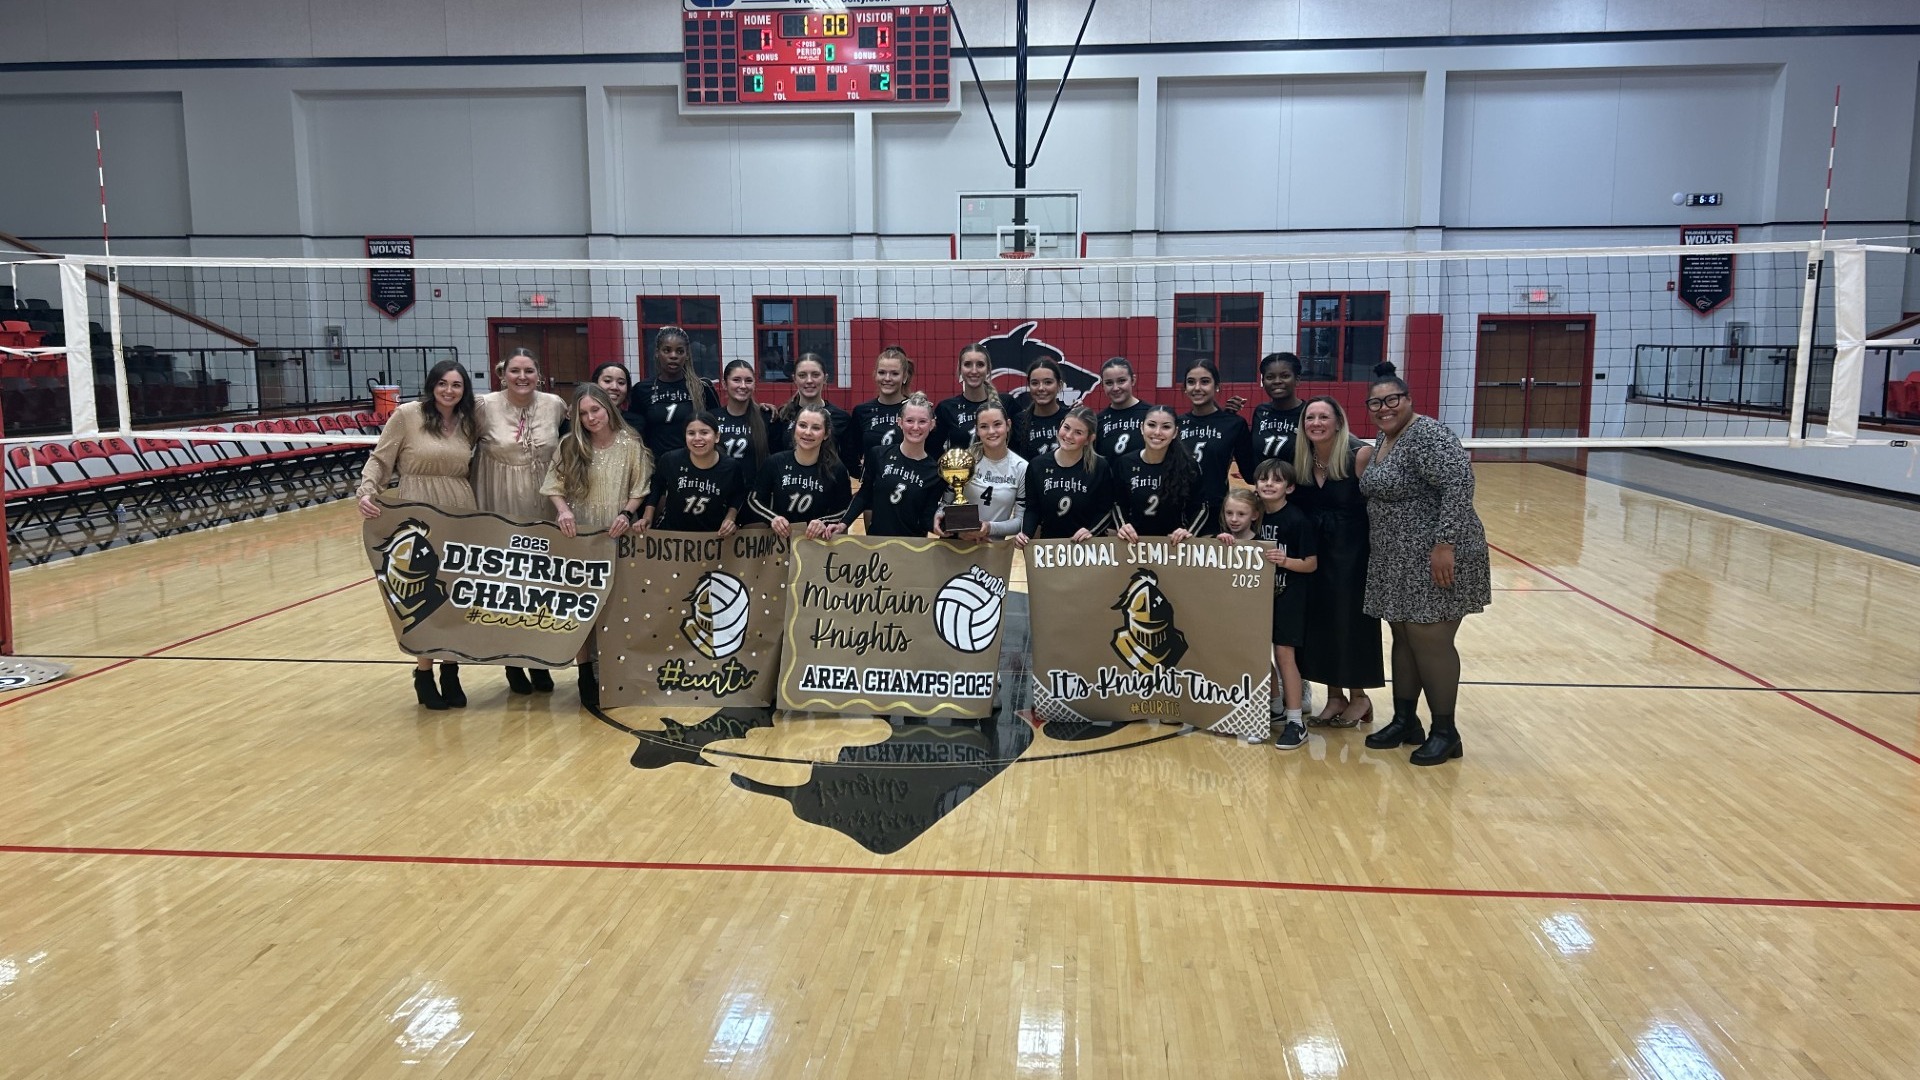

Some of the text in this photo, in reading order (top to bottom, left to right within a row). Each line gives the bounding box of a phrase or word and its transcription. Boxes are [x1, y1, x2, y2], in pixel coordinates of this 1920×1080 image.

[744, 15, 771, 25] HOME
[856, 12, 893, 23] VISITOR
[756, 53, 779, 61] BONUS
[796, 48, 821, 56] PERIOD
[825, 44, 835, 61] 0
[853, 52, 876, 60] BONUS
[742, 67, 763, 75] FOULS
[790, 66, 815, 74] PLAYER
[869, 65, 890, 73] FOULS
[754, 75, 763, 92] 0
[880, 73, 890, 91] 2
[1685, 235, 1733, 245] WOLVES
[369, 245, 412, 255] WOLVES
[665, 403, 678, 422] 1
[870, 413, 901, 430] Knigh
[1030, 426, 1058, 441] Knigh
[1103, 418, 1140, 437] Knight
[1180, 425, 1222, 440] Knights
[724, 438, 748, 458] 12
[1114, 433, 1130, 454] 8
[1192, 442, 1207, 463] 5
[1263, 435, 1288, 456] 17
[781, 474, 823, 492] Knights
[882, 463, 924, 488] Knights
[677, 476, 721, 496] Knights
[890, 483, 907, 504] 3
[1044, 477, 1087, 495] Knights
[683, 495, 710, 515] 15
[787, 492, 813, 513] 10
[980, 486, 993, 506] 4
[1144, 495, 1159, 516] 2
[1057, 496, 1072, 516] 9
[1260, 525, 1279, 540] AGLE
[511, 535, 550, 552] 2025
[618, 535, 724, 562] BI-DISTRICT
[442, 542, 611, 589] DISTRICT
[1033, 543, 1119, 568] REGIONAL
[1126, 542, 1264, 571] SEMI-FINALISTS
[823, 552, 893, 588] Eagle
[1232, 574, 1260, 588] 2025
[451, 578, 599, 621] CHAMPS
[802, 581, 929, 615] Mountain
[466, 608, 579, 632] #curtis
[810, 618, 912, 655] Knights
[800, 665, 994, 698] AREA CHAMPS 2025
[1049, 664, 1250, 708] It's Knight Time!
[1130, 701, 1180, 717] #CURTIS
